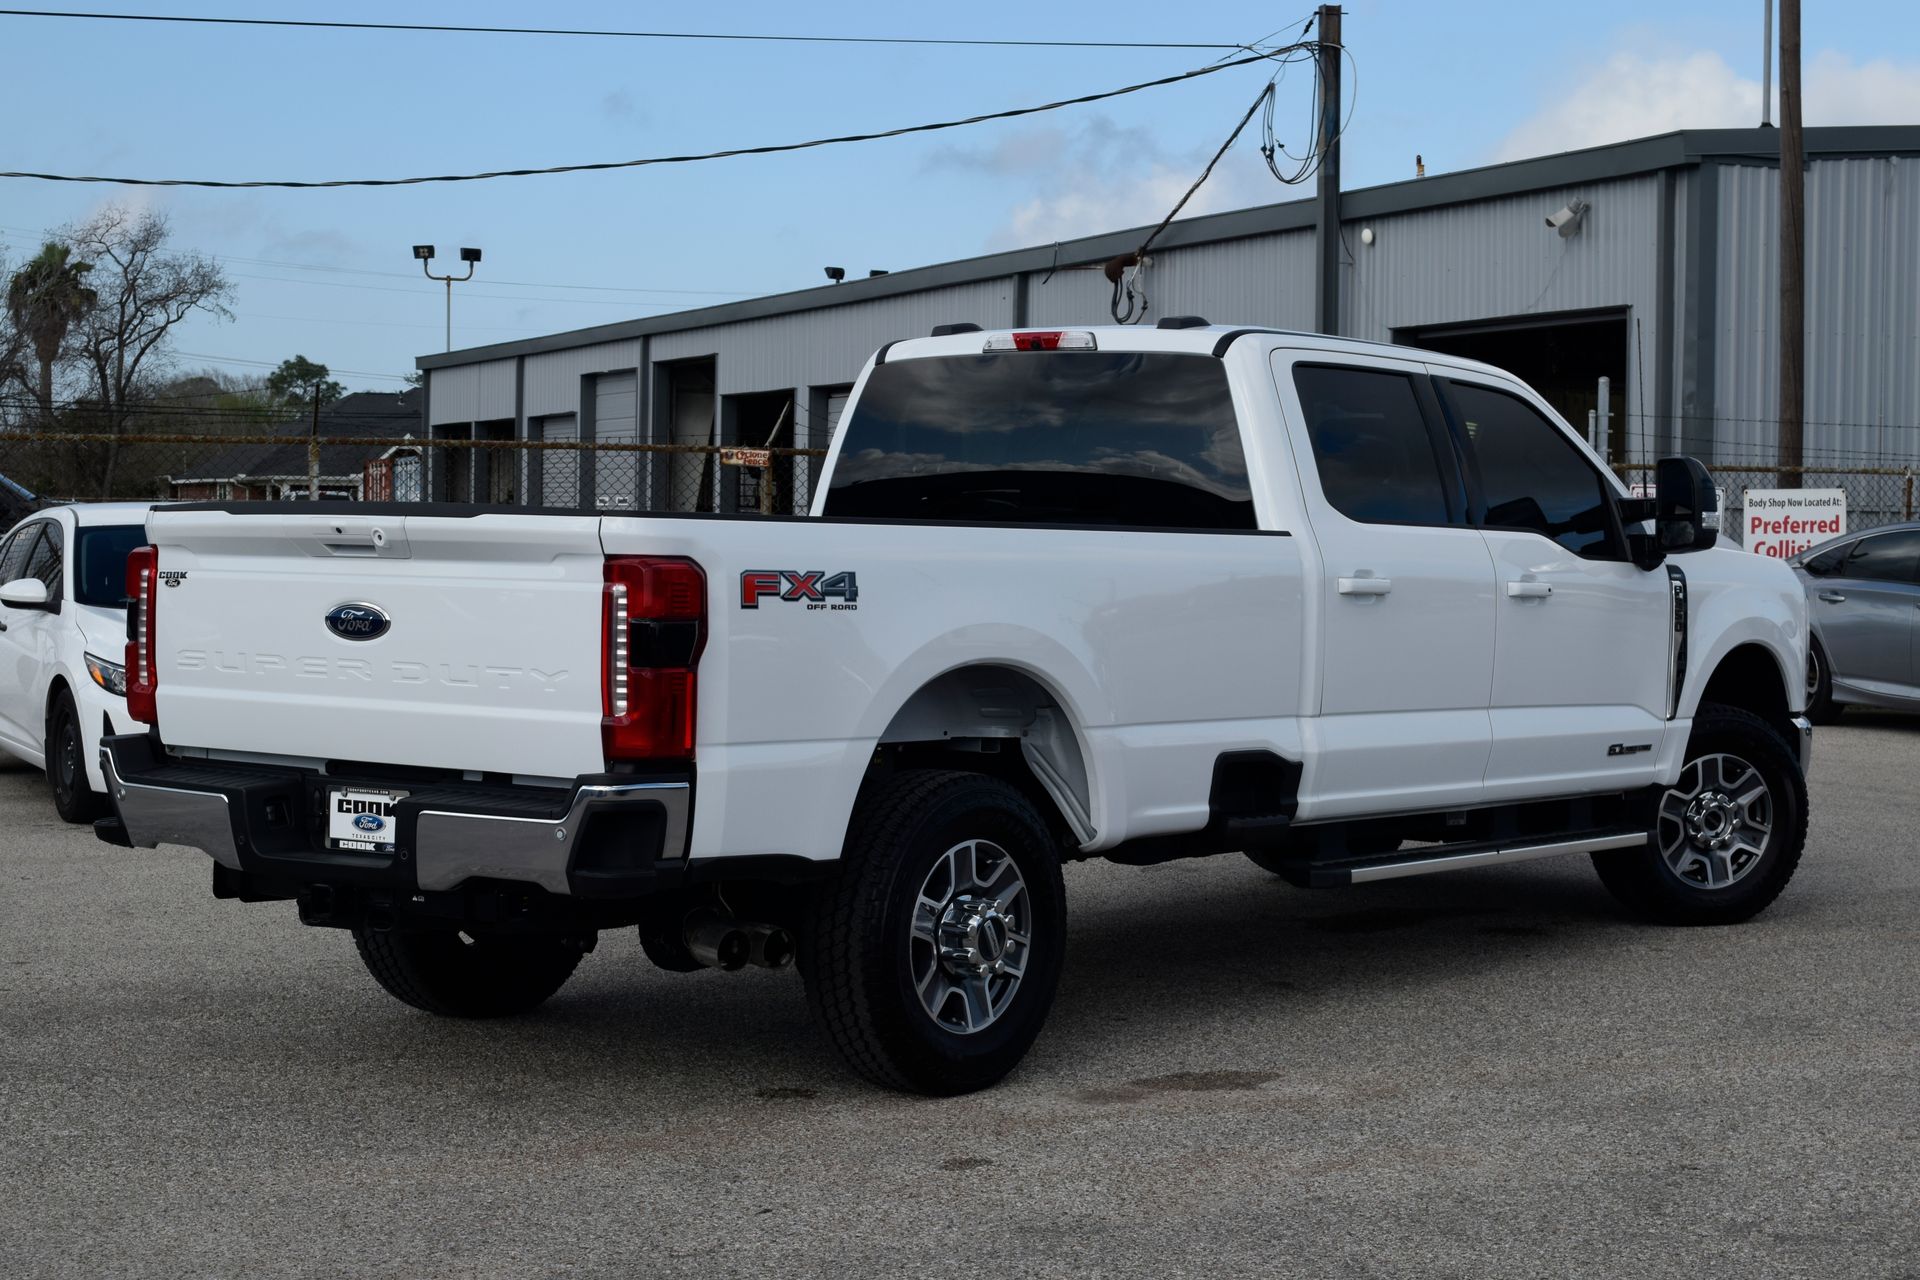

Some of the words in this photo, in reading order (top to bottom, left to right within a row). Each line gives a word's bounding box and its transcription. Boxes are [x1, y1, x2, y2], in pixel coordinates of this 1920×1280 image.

[1749, 498, 1766, 509] Body
[1768, 498, 1786, 509] Shop
[1788, 498, 1803, 507] Now
[1804, 497, 1831, 507] Located
[1832, 497, 1842, 506] At:
[1751, 514, 1840, 534] Preferred
[1754, 539, 1812, 558] Collisi
[159, 571, 188, 579] COOK
[741, 570, 858, 609] FX4
[338, 609, 373, 631] Ford
[177, 650, 372, 681] SUPER
[392, 660, 569, 692] DUTY
[338, 798, 397, 817] COOK
[359, 816, 378, 829] Ford
[339, 840, 376, 851] COOK
